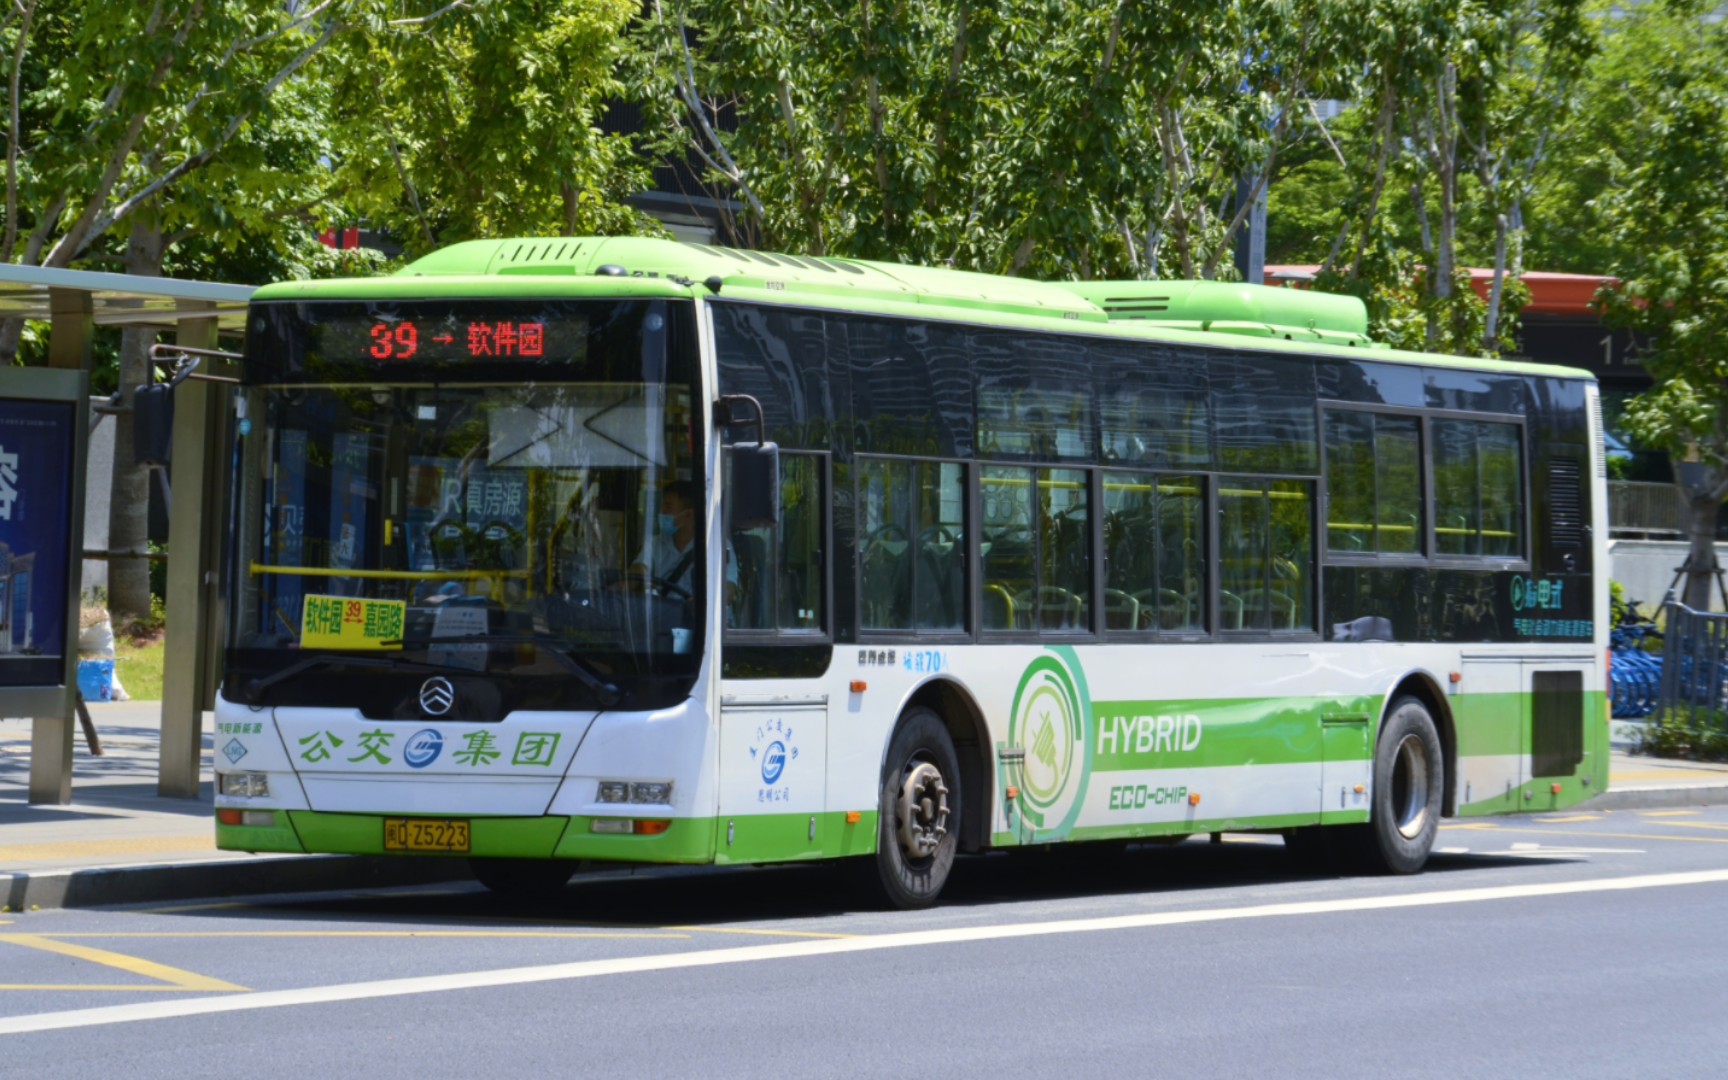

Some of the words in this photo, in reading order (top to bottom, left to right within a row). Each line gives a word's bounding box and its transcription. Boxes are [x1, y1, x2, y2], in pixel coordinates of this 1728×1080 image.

[370, 322, 418, 359] 39
[468, 321, 543, 356] 软件园
[306, 597, 343, 635] 软件园
[345, 601, 362, 617] 39
[364, 602, 403, 640] 嘉园路
[1097, 714, 1203, 755] HYBRID
[1109, 784, 1188, 811] ECO-CHIP
